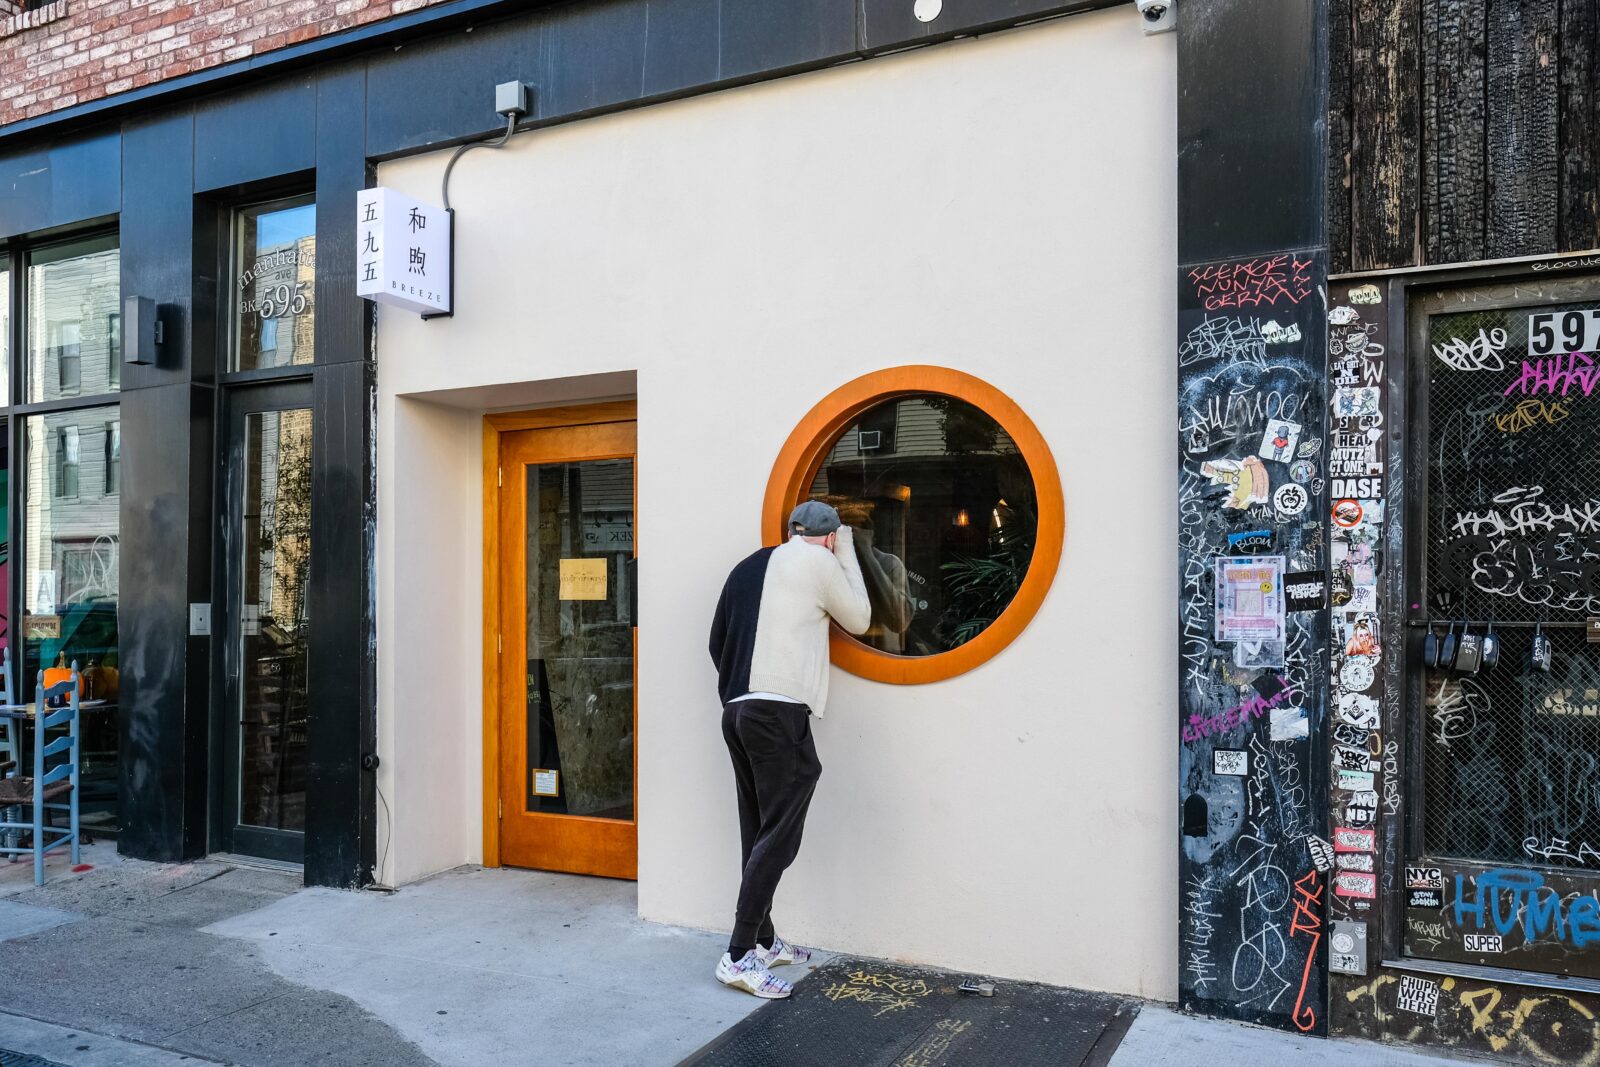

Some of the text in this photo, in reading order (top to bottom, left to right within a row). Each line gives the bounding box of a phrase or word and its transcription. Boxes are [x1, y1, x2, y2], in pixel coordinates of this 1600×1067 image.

[361, 201, 379, 282] 五九五
[408, 206, 426, 277] 和煦
[275, 269, 292, 280] ave
[240, 282, 306, 318] BK 595
[392, 280, 441, 303] BREEZE
[1350, 288, 1378, 301] COMA
[1333, 361, 1345, 370] EAT
[1335, 375, 1359, 385] DIE
[1331, 478, 1382, 499] DASE
[1406, 868, 1440, 880] NYC
[1413, 891, 1434, 899] STAY
[1465, 935, 1501, 951] SUPER
[1401, 986, 1435, 1004] WAS
[1397, 997, 1436, 1016] HERE
